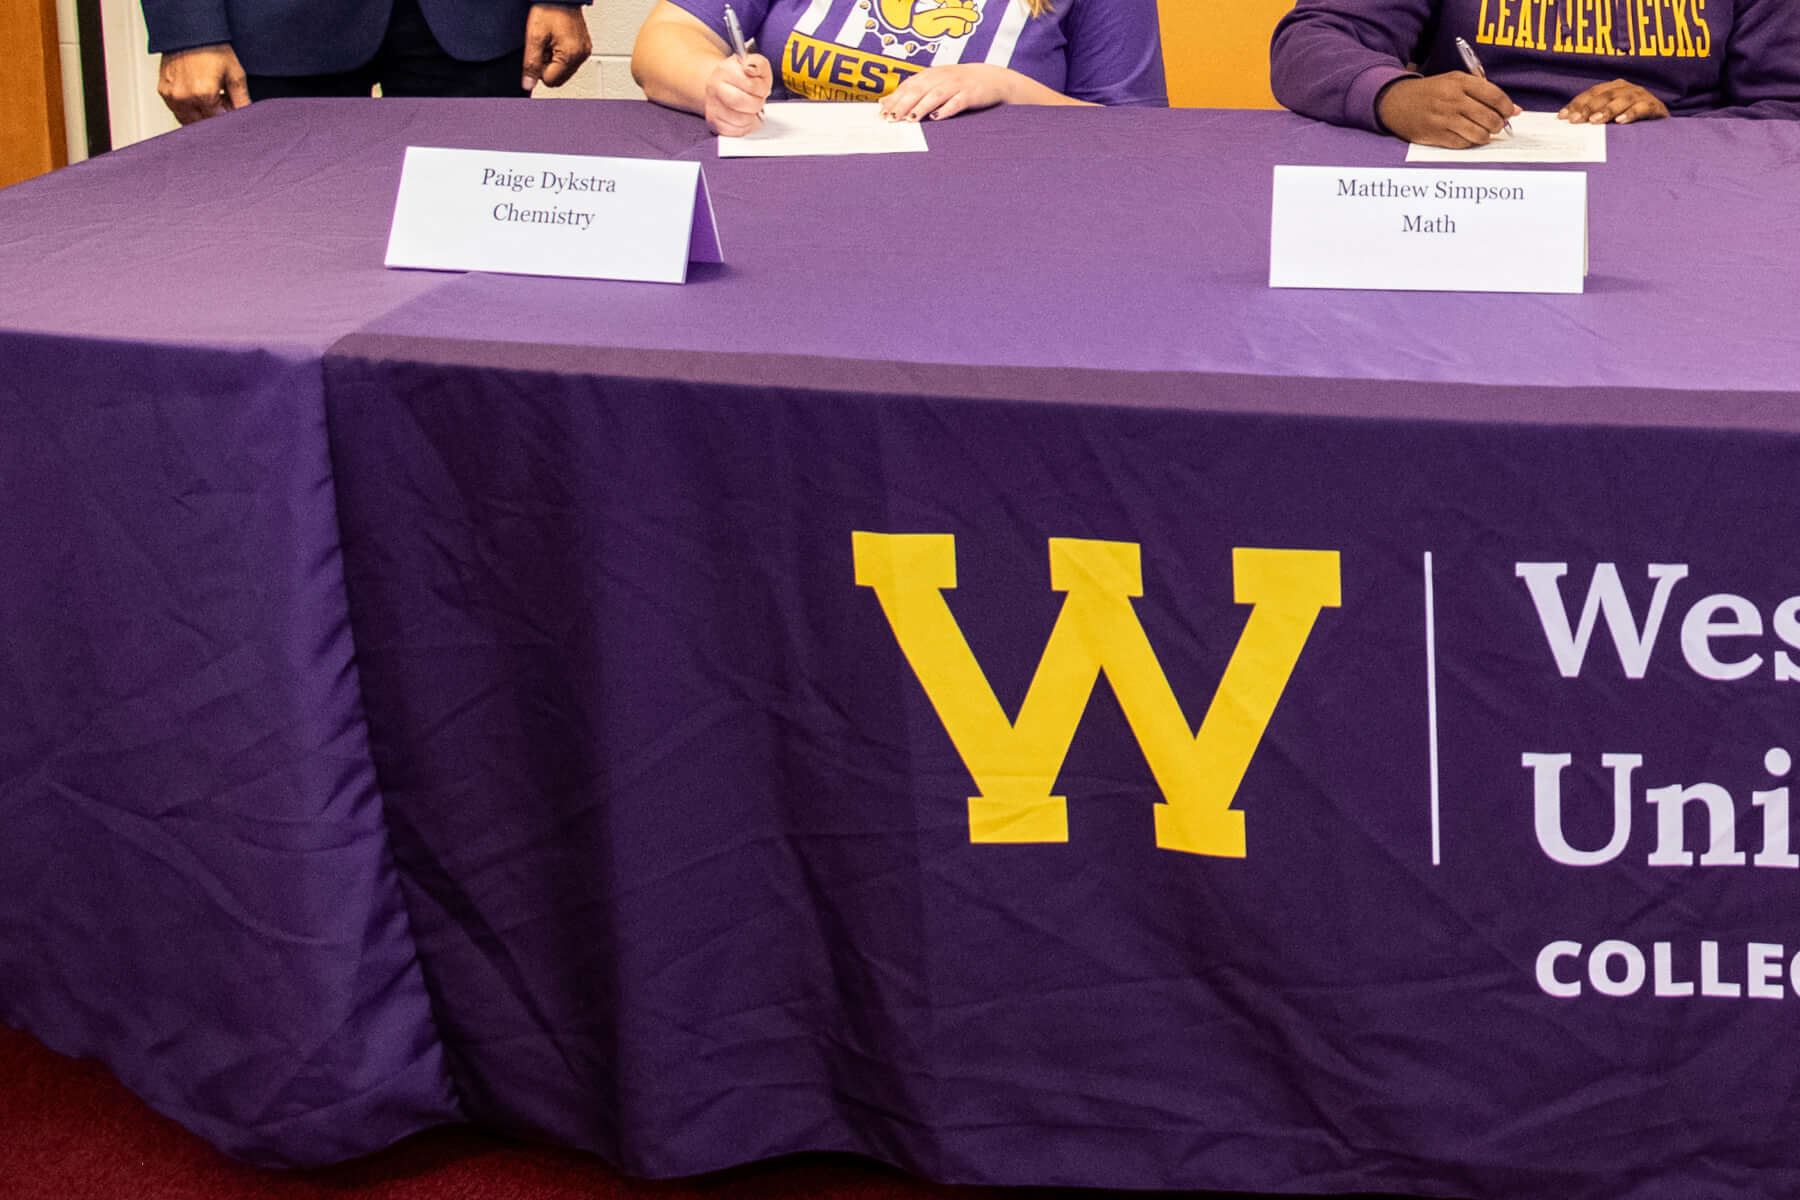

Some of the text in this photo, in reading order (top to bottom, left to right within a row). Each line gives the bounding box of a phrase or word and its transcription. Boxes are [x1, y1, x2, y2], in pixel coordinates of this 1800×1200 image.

[481, 167, 617, 194] Paige Dykstra
[1337, 178, 1525, 205] Matthew Simpson
[492, 202, 596, 231] Chemistry
[1402, 214, 1457, 234] Math
[851, 530, 1342, 859] W
